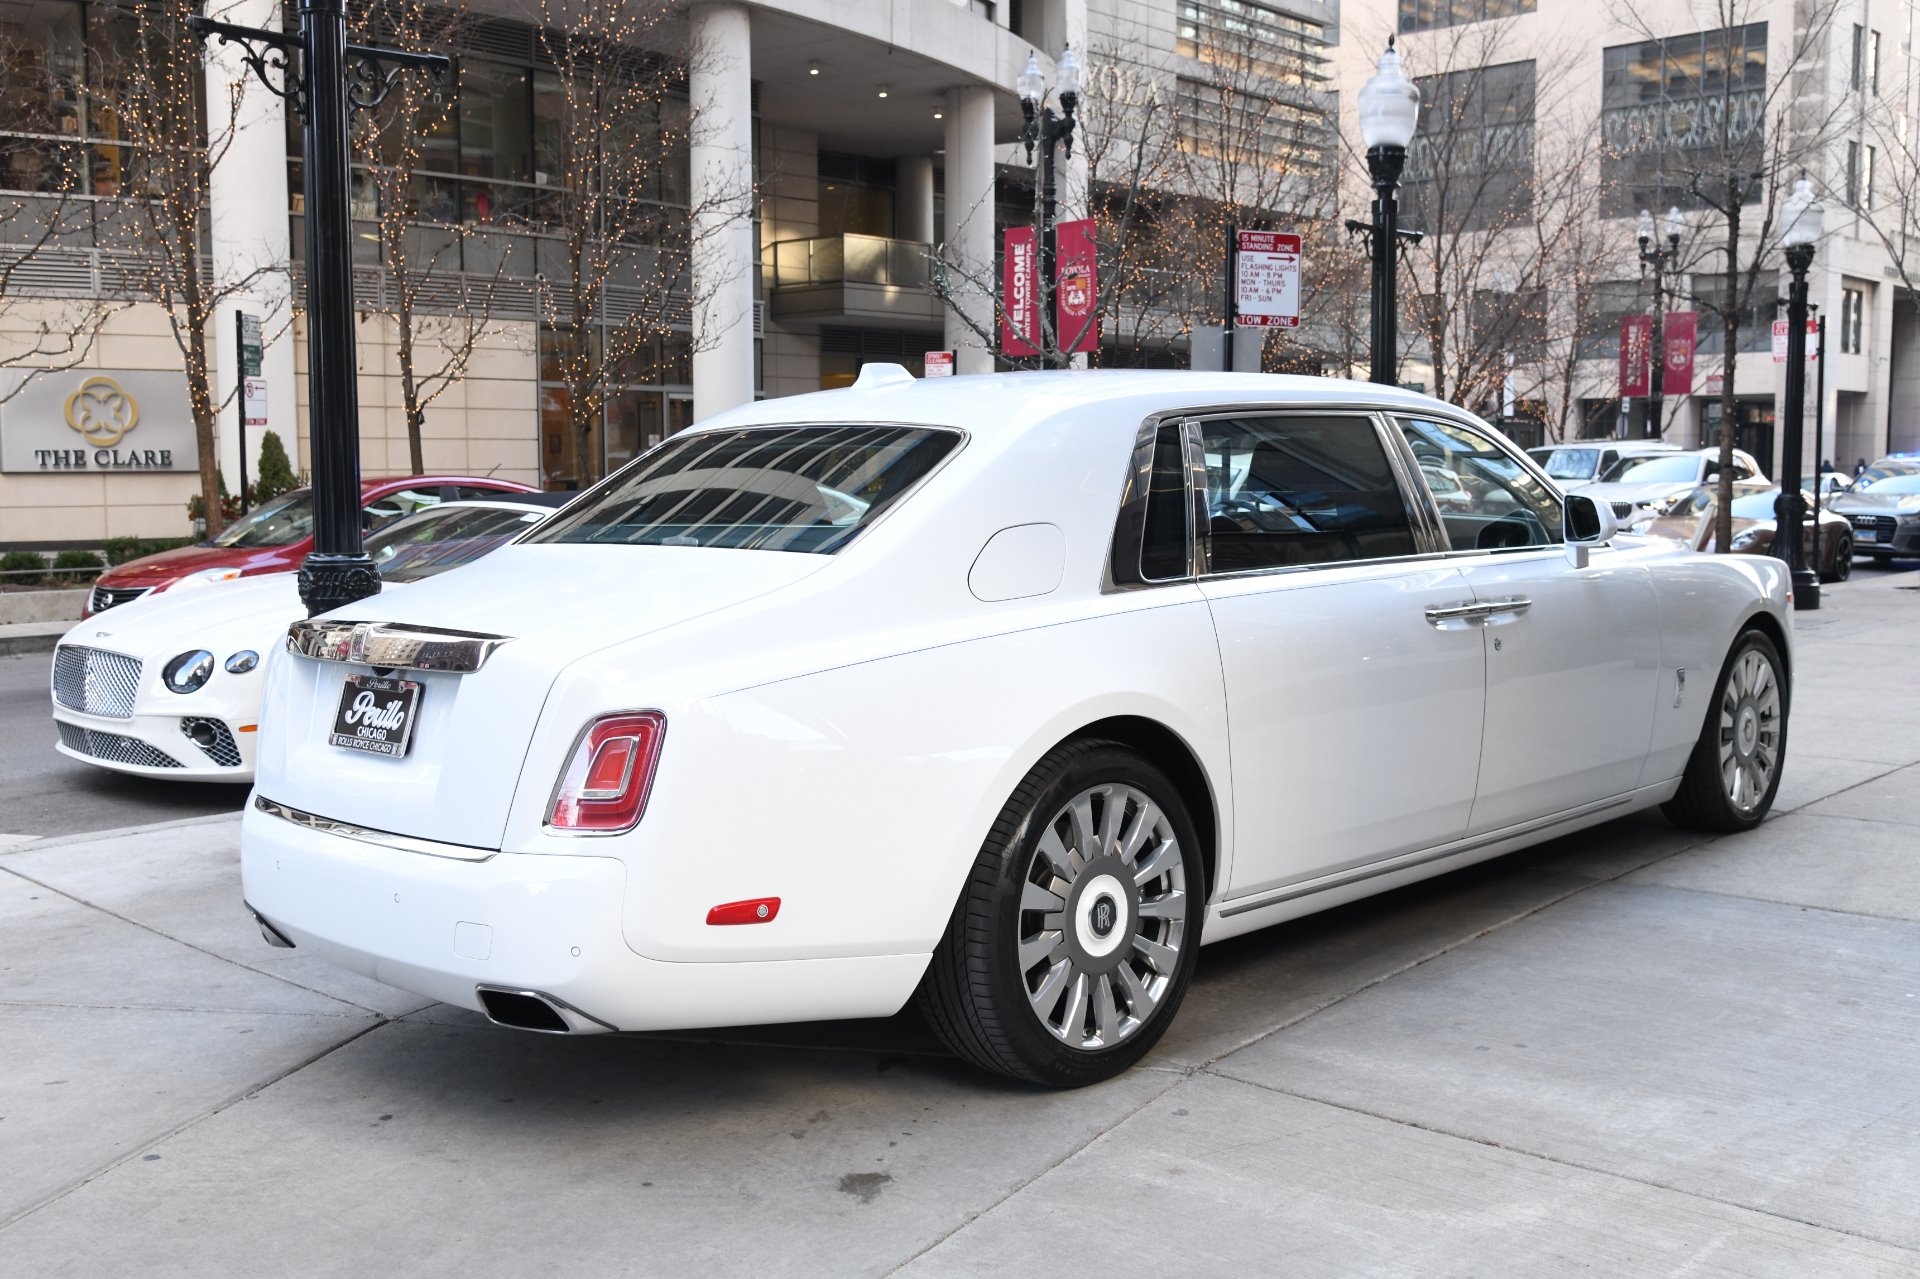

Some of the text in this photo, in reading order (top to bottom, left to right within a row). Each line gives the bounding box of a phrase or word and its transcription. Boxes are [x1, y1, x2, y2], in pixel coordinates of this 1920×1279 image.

[1251, 235, 1275, 243] MINUTE
[1242, 242, 1294, 252] STANDING ZONE
[1241, 263, 1297, 273] FLASHING LIGHTS
[1263, 279, 1286, 287] THURS
[1241, 315, 1294, 326] TOW ZONE
[35, 449, 173, 469] THE CLARE
[366, 679, 391, 690] Perillo
[345, 691, 405, 731] Perillo
[357, 726, 387, 740] CHICAGO
[338, 737, 392, 753] ROLLS ROYCE CHICAGO
